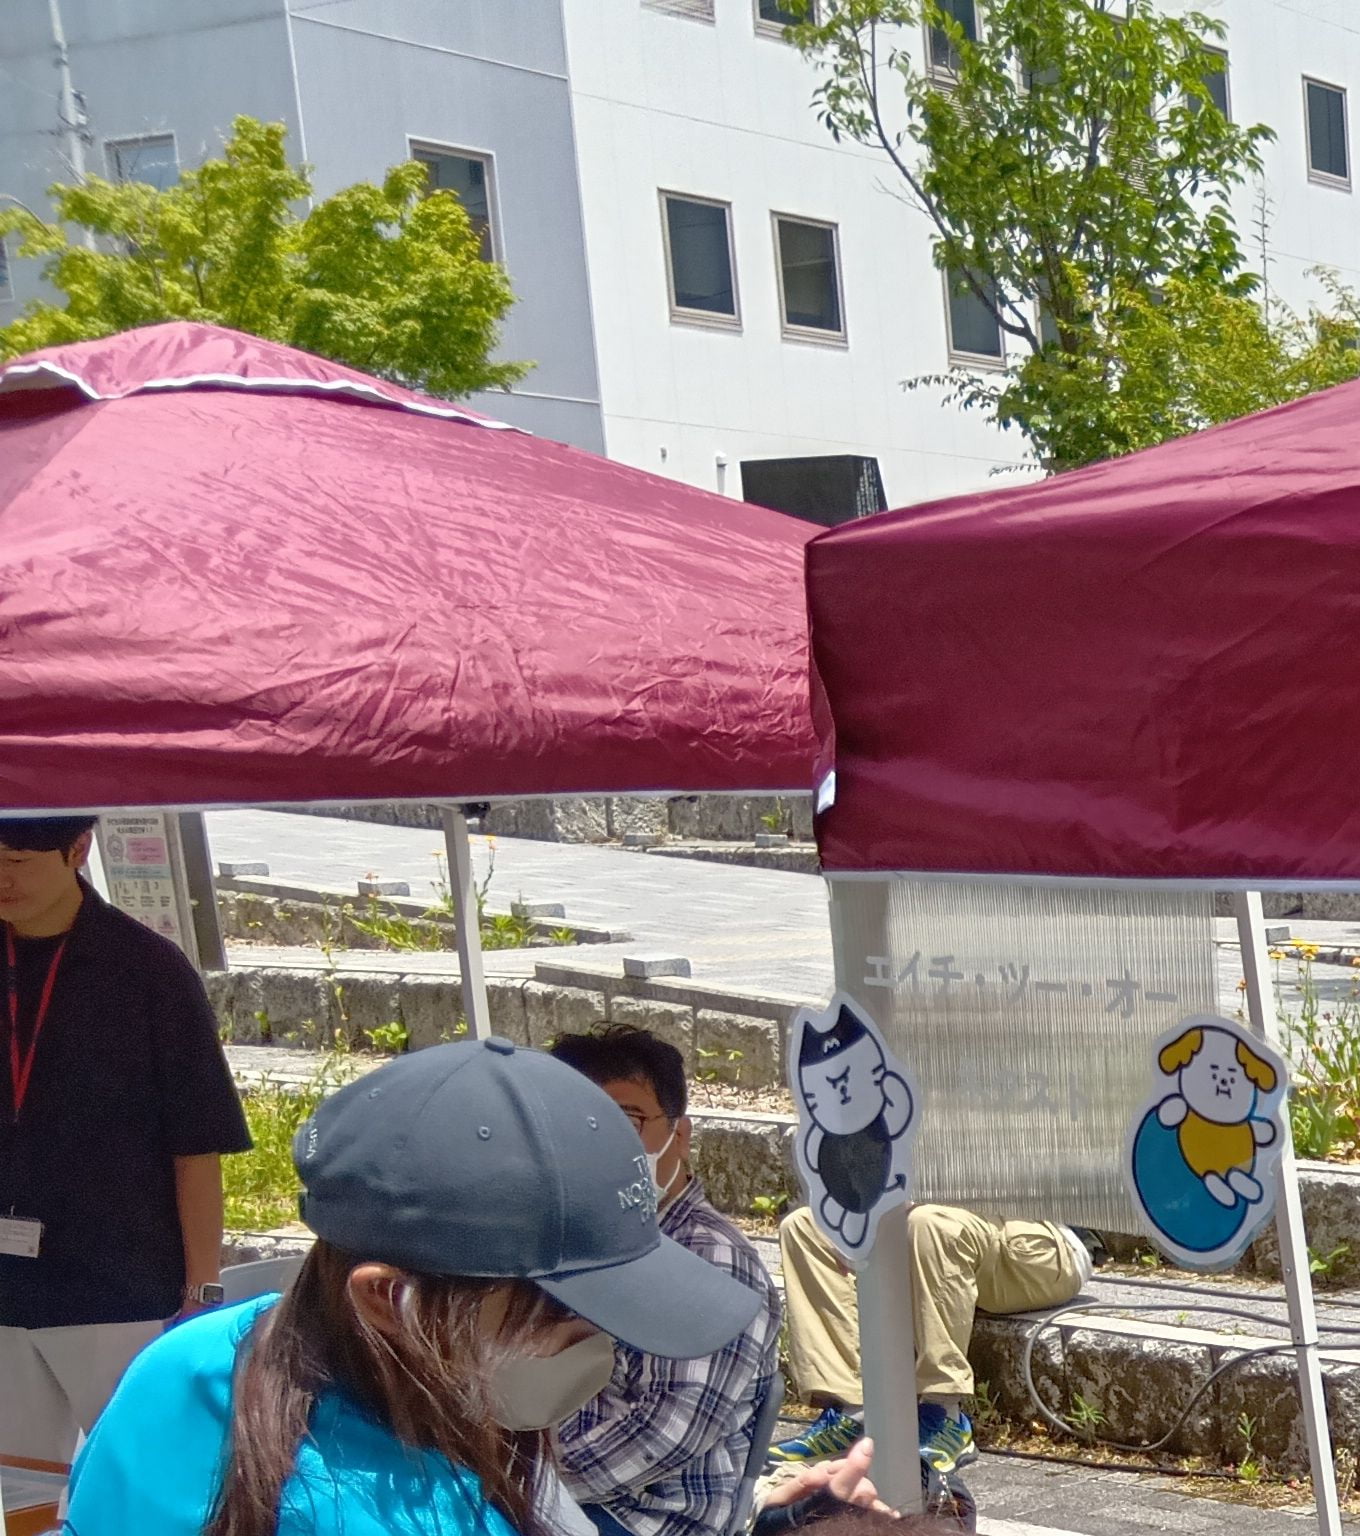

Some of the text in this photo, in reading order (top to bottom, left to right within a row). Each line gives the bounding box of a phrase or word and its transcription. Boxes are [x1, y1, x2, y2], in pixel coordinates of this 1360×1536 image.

[864, 951, 1177, 1018] エイチ・ツー・オー
